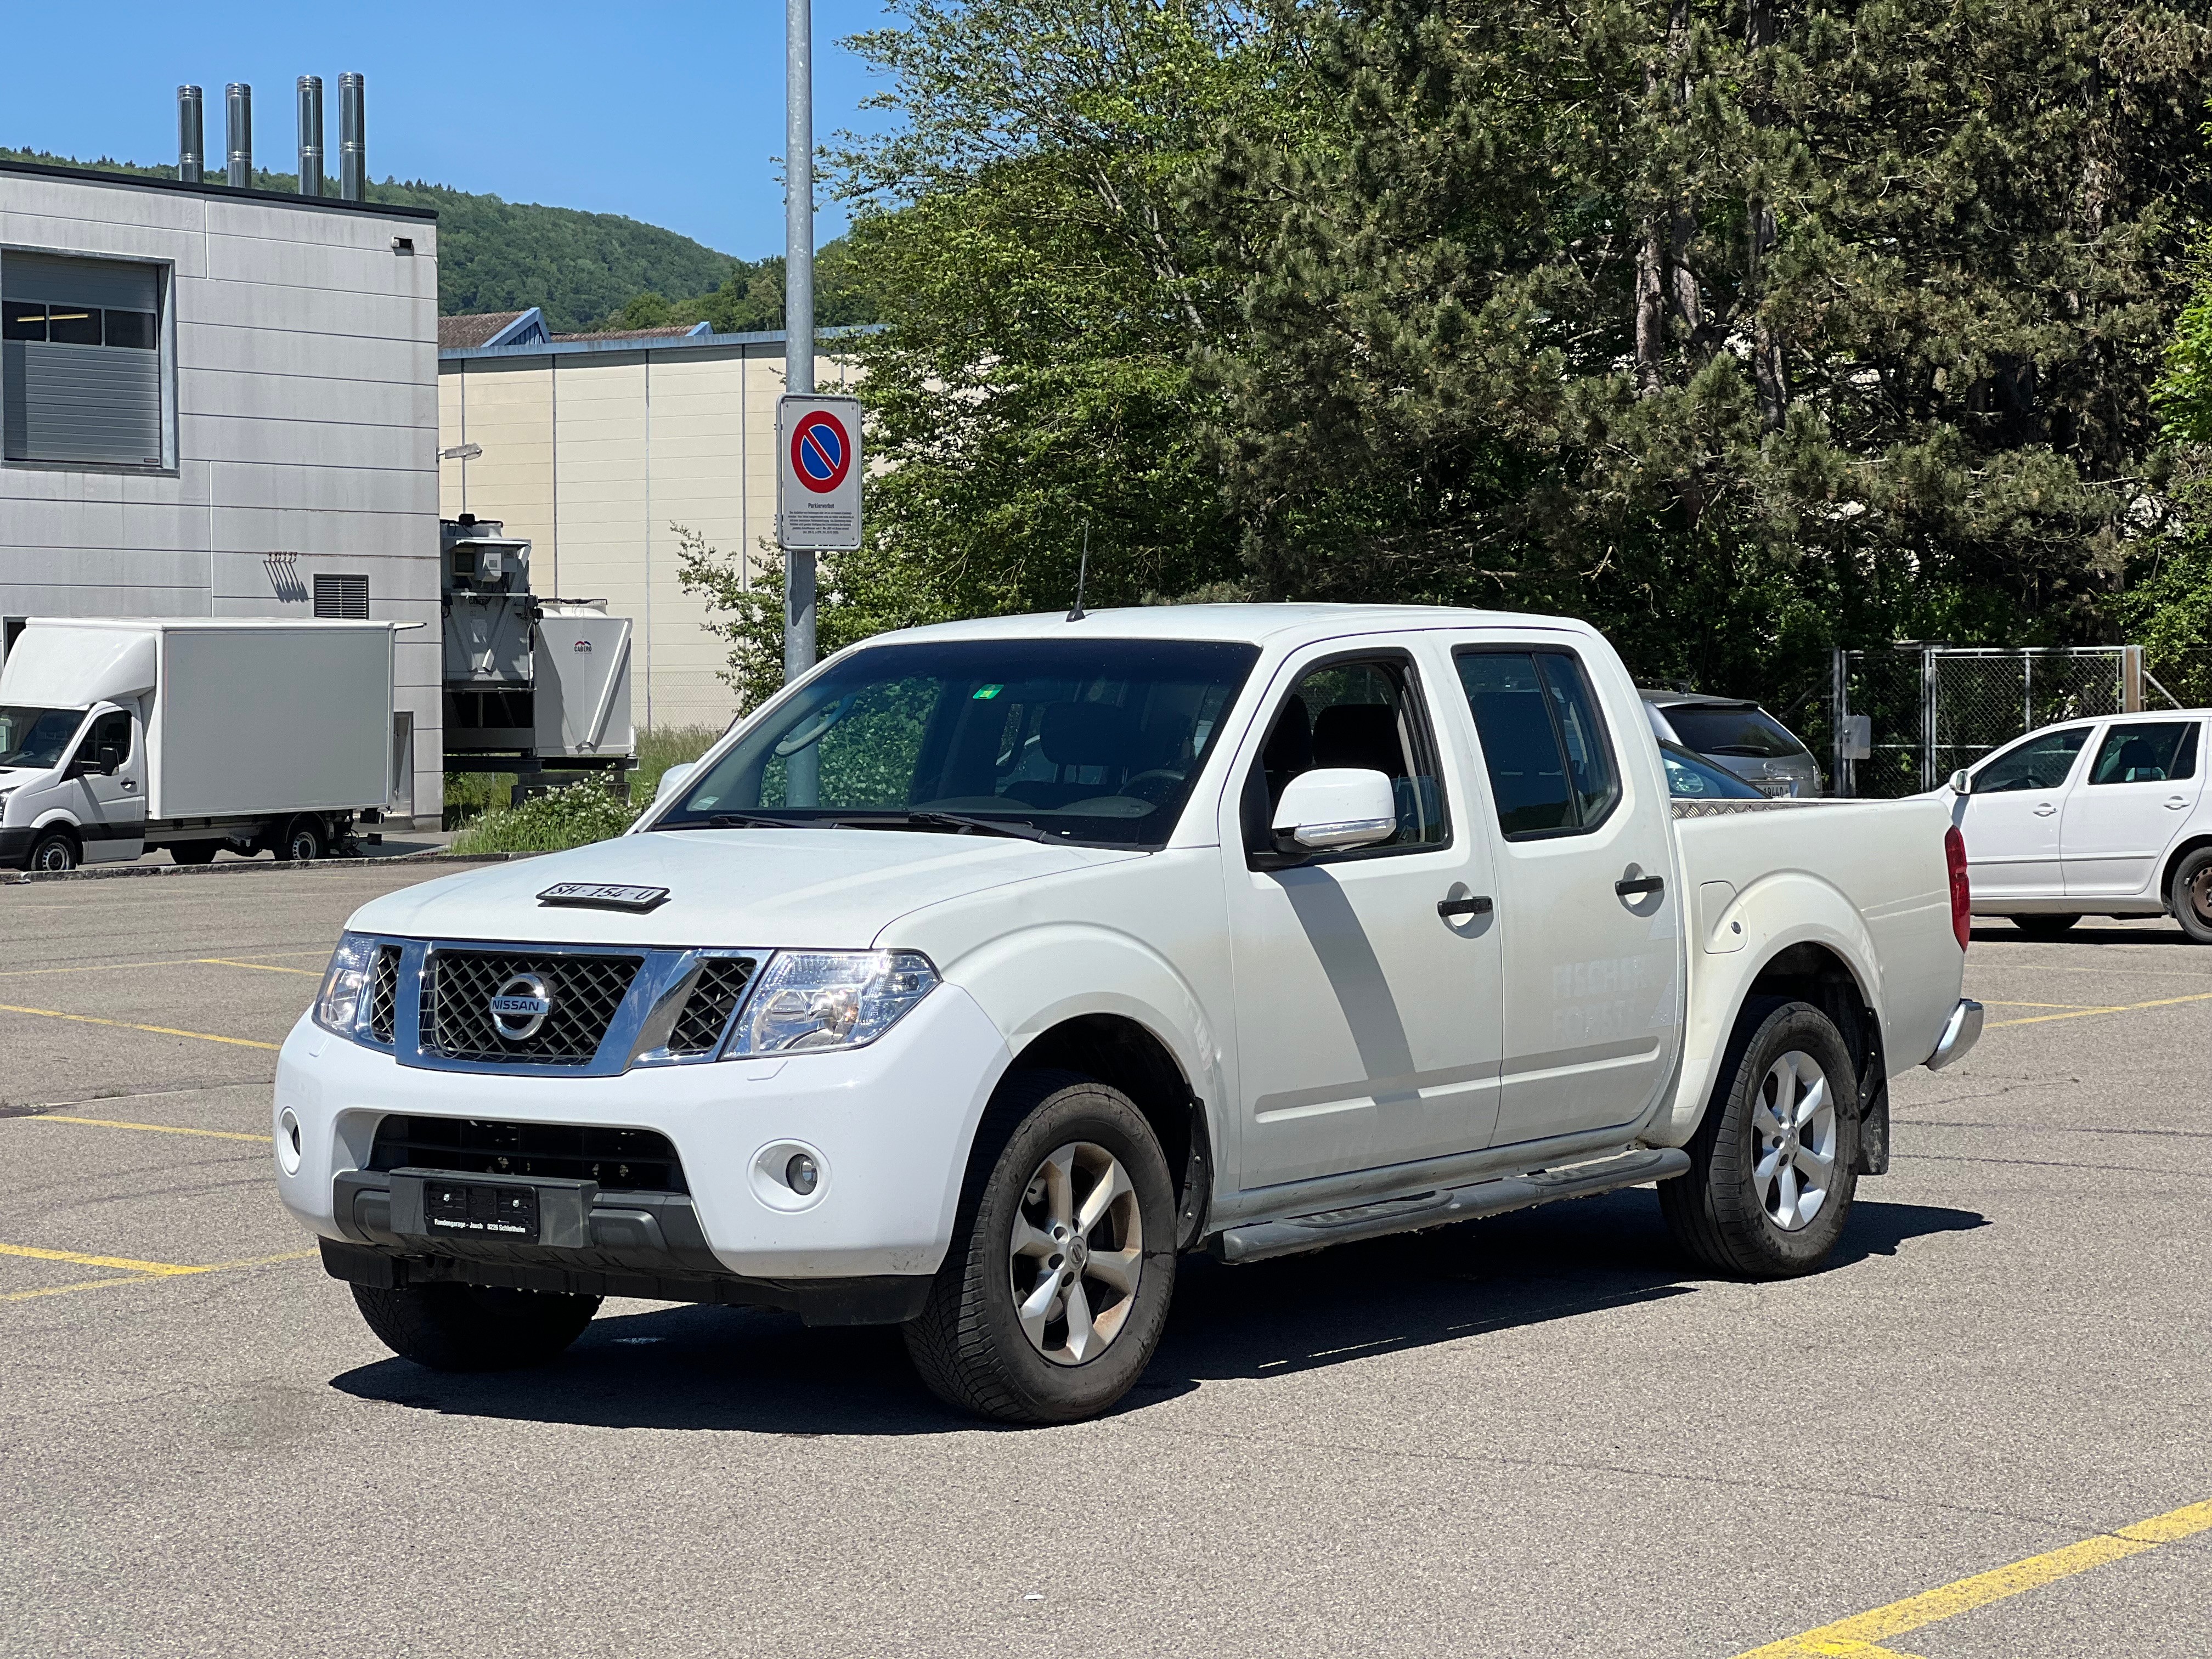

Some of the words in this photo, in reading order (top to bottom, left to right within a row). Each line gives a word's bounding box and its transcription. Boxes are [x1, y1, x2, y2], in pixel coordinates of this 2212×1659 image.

[549, 885, 583, 895] SH
[586, 887, 628, 897] 154
[634, 890, 657, 900] U
[492, 1000, 539, 1011] NISSAN
